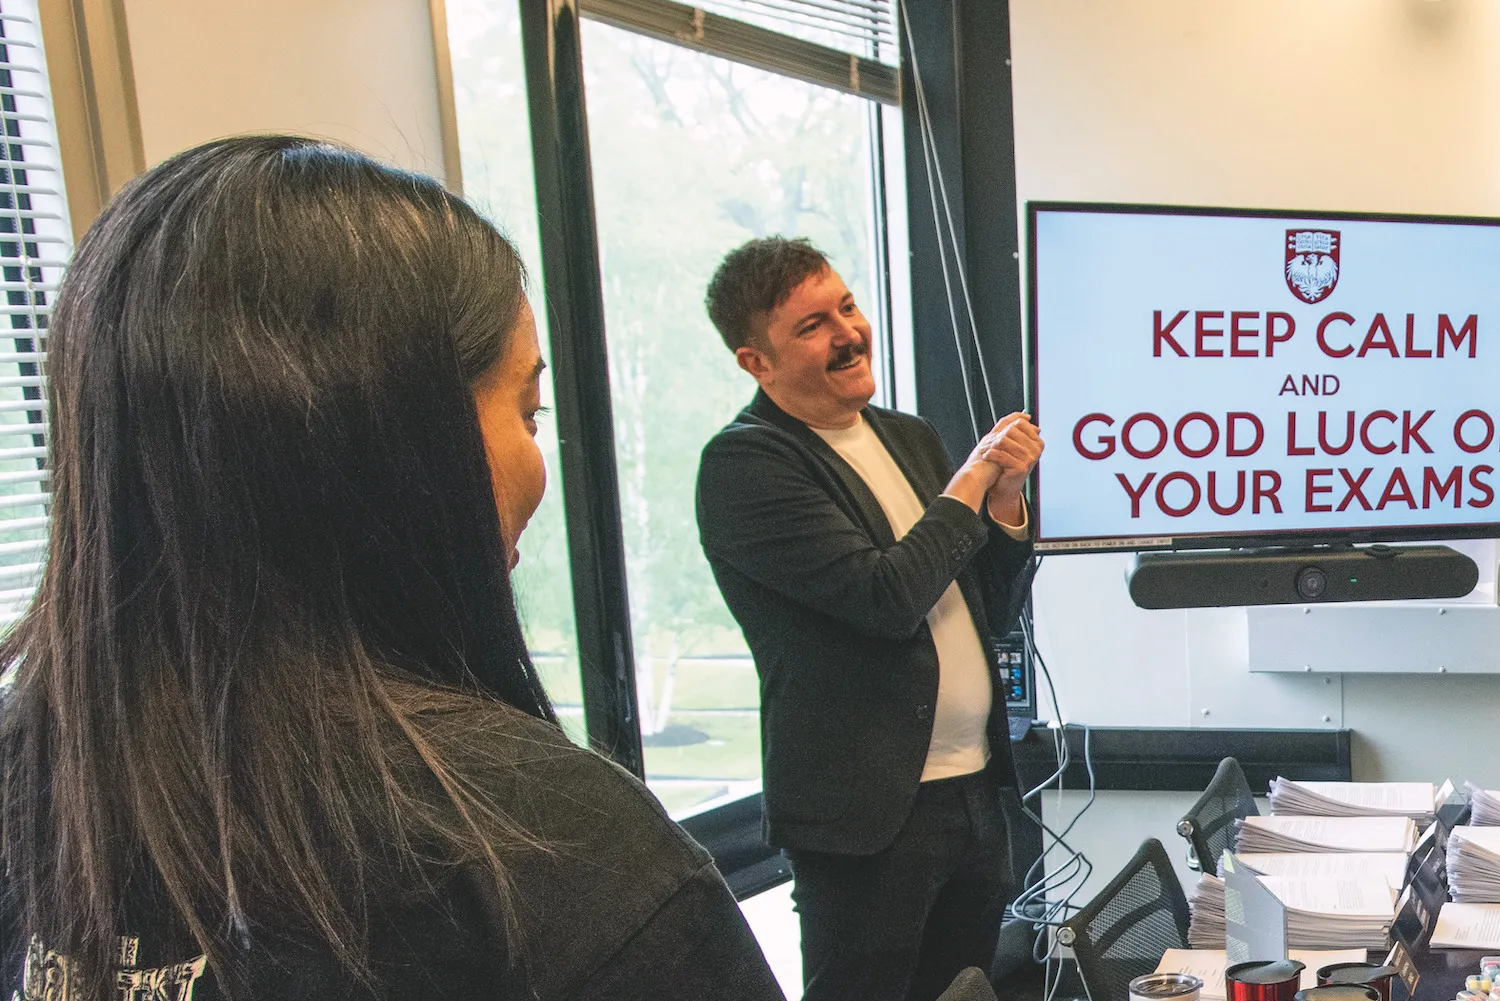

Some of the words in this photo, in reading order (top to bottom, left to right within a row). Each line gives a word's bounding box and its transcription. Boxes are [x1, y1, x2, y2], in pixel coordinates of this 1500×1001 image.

[1153, 311, 1296, 358] KEEP
[1316, 312, 1478, 358] CALM
[1279, 375, 1340, 396] AND
[1072, 412, 1264, 460] GOOD
[1287, 410, 1435, 456] LUCK
[1115, 470, 1283, 518] YOUR
[1305, 465, 1494, 513] EXAMS
